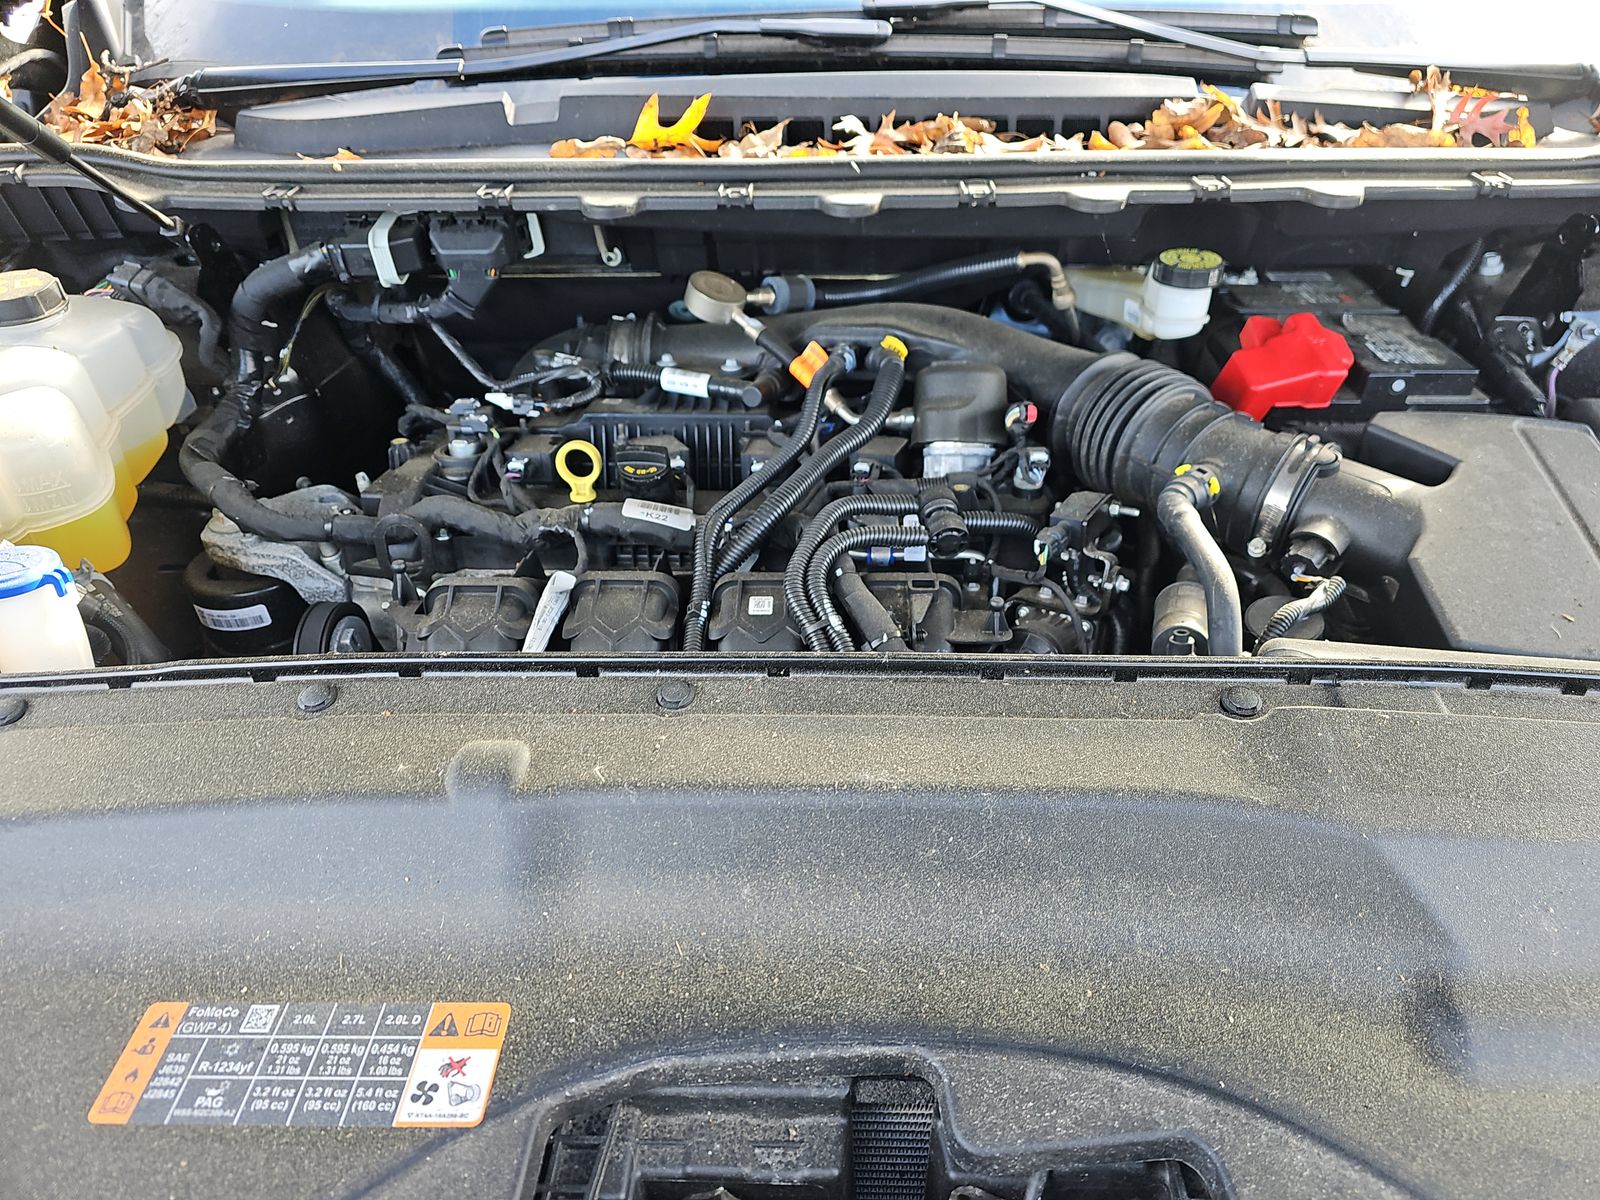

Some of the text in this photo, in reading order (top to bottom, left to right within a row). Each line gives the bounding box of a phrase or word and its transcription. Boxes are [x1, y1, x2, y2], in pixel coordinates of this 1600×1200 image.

[188, 1006, 239, 1018] FoMoCo
[293, 1014, 316, 1024] 2.0L
[342, 1014, 366, 1024] 2.7L
[384, 1014, 422, 1024] 2.0L D
[176, 1022, 232, 1034] (GWP 4)
[300, 1044, 315, 1056] kg
[350, 1044, 365, 1056] kg
[371, 1044, 416, 1056] 0.454 kg
[166, 1052, 191, 1062] SAE
[276, 1056, 300, 1064] 21 oz
[326, 1056, 351, 1064] 21 oz
[390, 1056, 402, 1064] oz
[198, 1060, 254, 1074] R-1234yf
[286, 1066, 300, 1076] lbs
[338, 1066, 352, 1076] lbs
[388, 1066, 403, 1076] lbs
[252, 1086, 271, 1097] 3.2
[281, 1088, 296, 1097] oz
[304, 1086, 322, 1097] 3.2
[333, 1088, 348, 1097] oz
[356, 1086, 373, 1097] 5.4
[384, 1088, 400, 1097] oz
[194, 1096, 223, 1108] PAG
[250, 1100, 288, 1112] (95 cc)
[303, 1100, 341, 1112] (95 cc)
[377, 1100, 396, 1112] cc)
